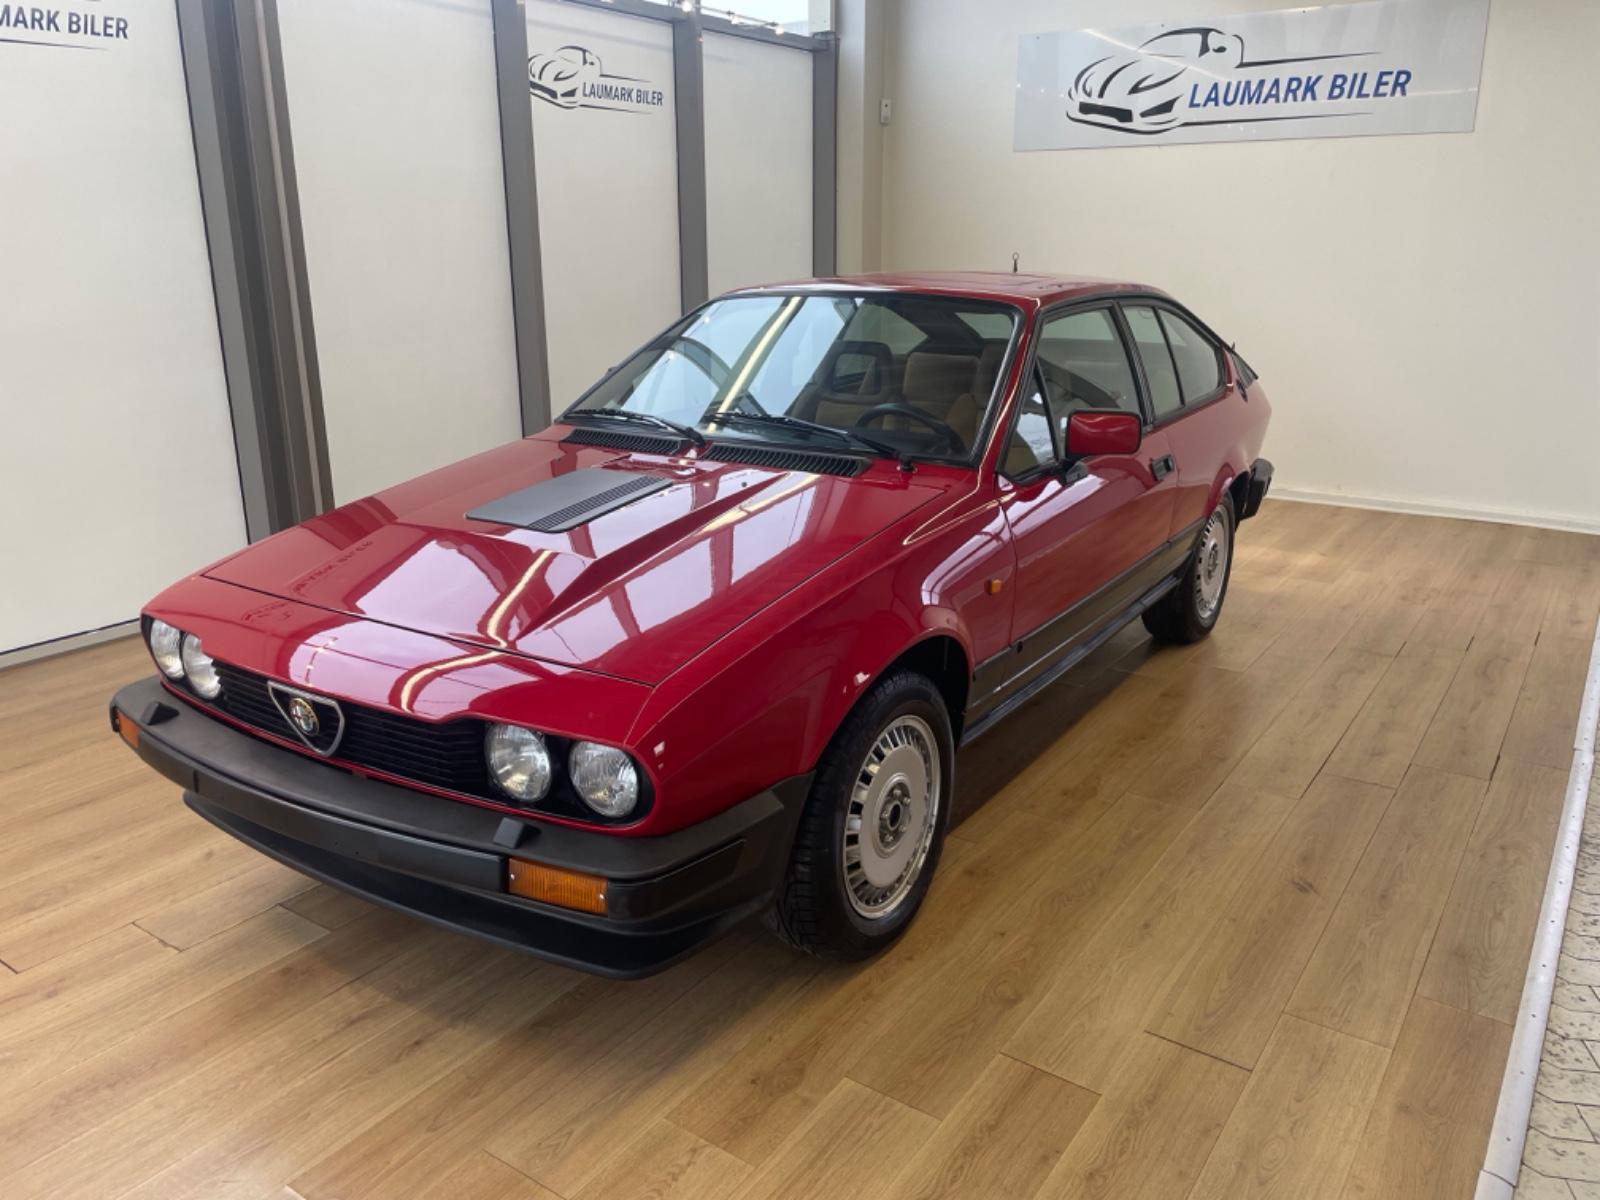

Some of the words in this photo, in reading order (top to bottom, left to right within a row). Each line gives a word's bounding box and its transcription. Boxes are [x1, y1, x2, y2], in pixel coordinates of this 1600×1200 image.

[68, 12, 129, 39] BILER
[582, 82, 634, 103] LAUMARK
[636, 88, 663, 106] BILER
[1188, 75, 1323, 108] LAUMARK
[1327, 69, 1412, 101] BILER
